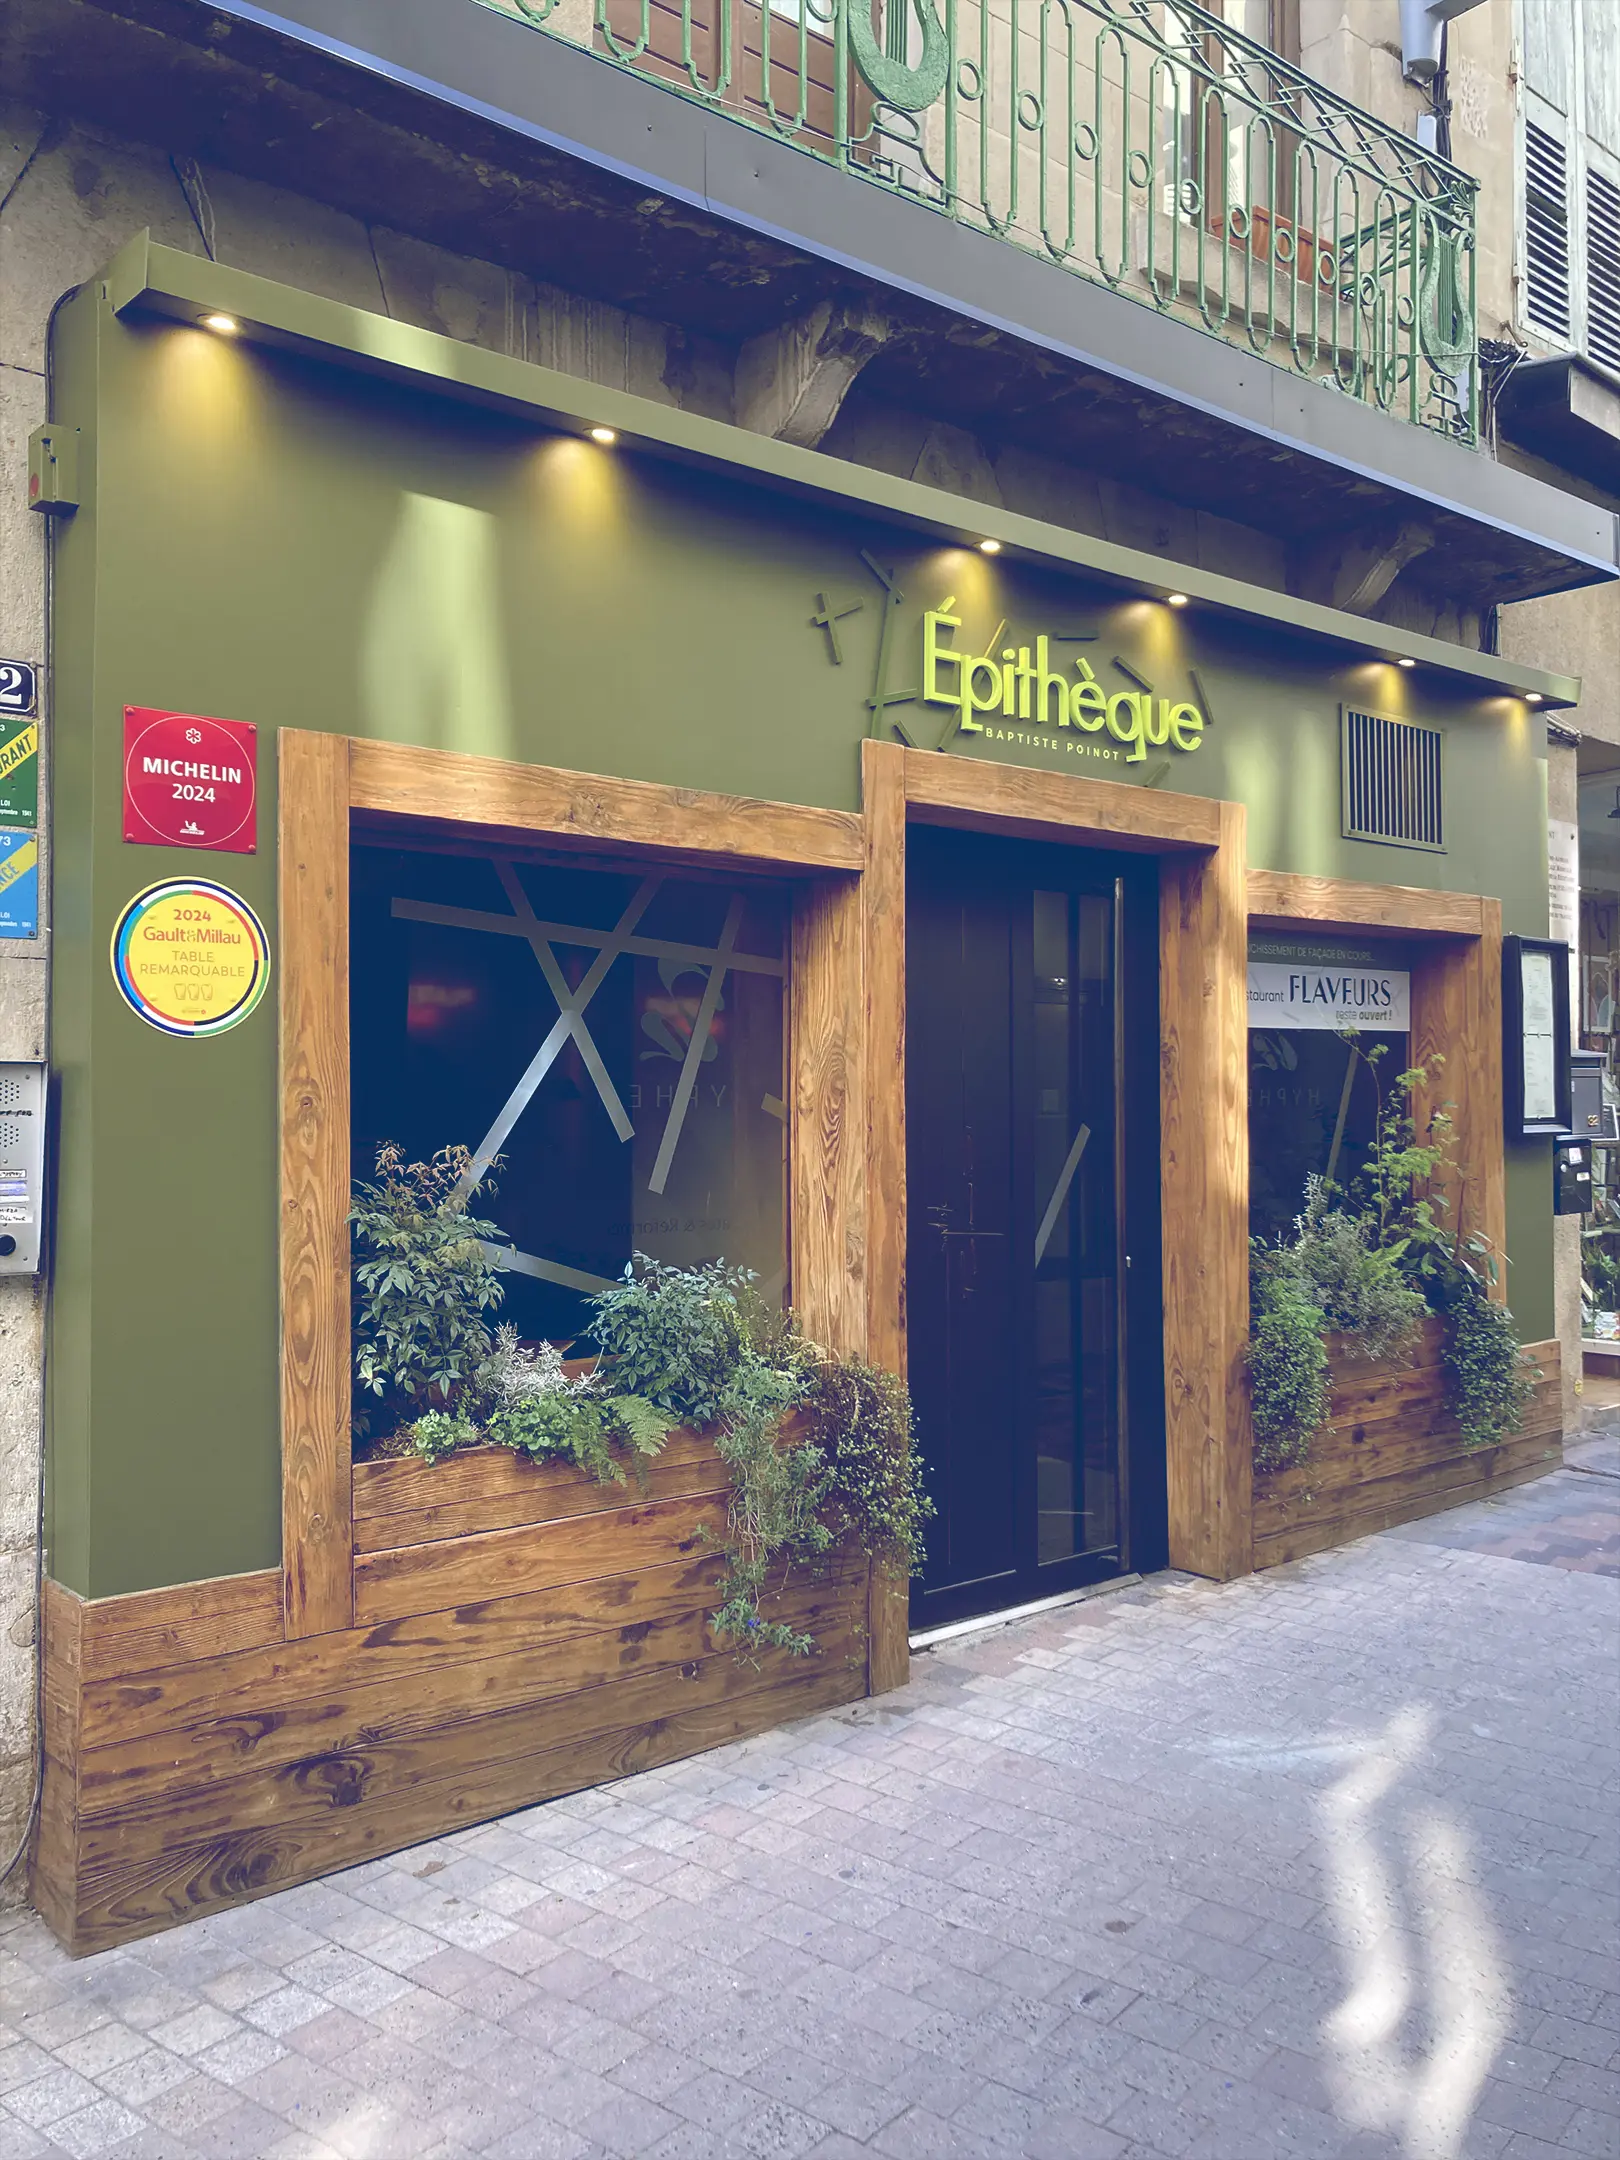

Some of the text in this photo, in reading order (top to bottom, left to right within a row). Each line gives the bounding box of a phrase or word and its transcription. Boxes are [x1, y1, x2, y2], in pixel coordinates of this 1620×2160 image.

[923, 595, 1203, 763] Épithèque
[985, 727, 1119, 761] BAPTISTE POINOT
[143, 756, 241, 784] MICHELIN
[172, 783, 216, 803] 2024
[173, 908, 212, 922] 2024
[143, 926, 241, 945] Gault&Millau
[172, 950, 215, 963] TABLE
[140, 963, 246, 978] REMARQUABLE
[1289, 974, 1391, 1007] FLAVEURS
